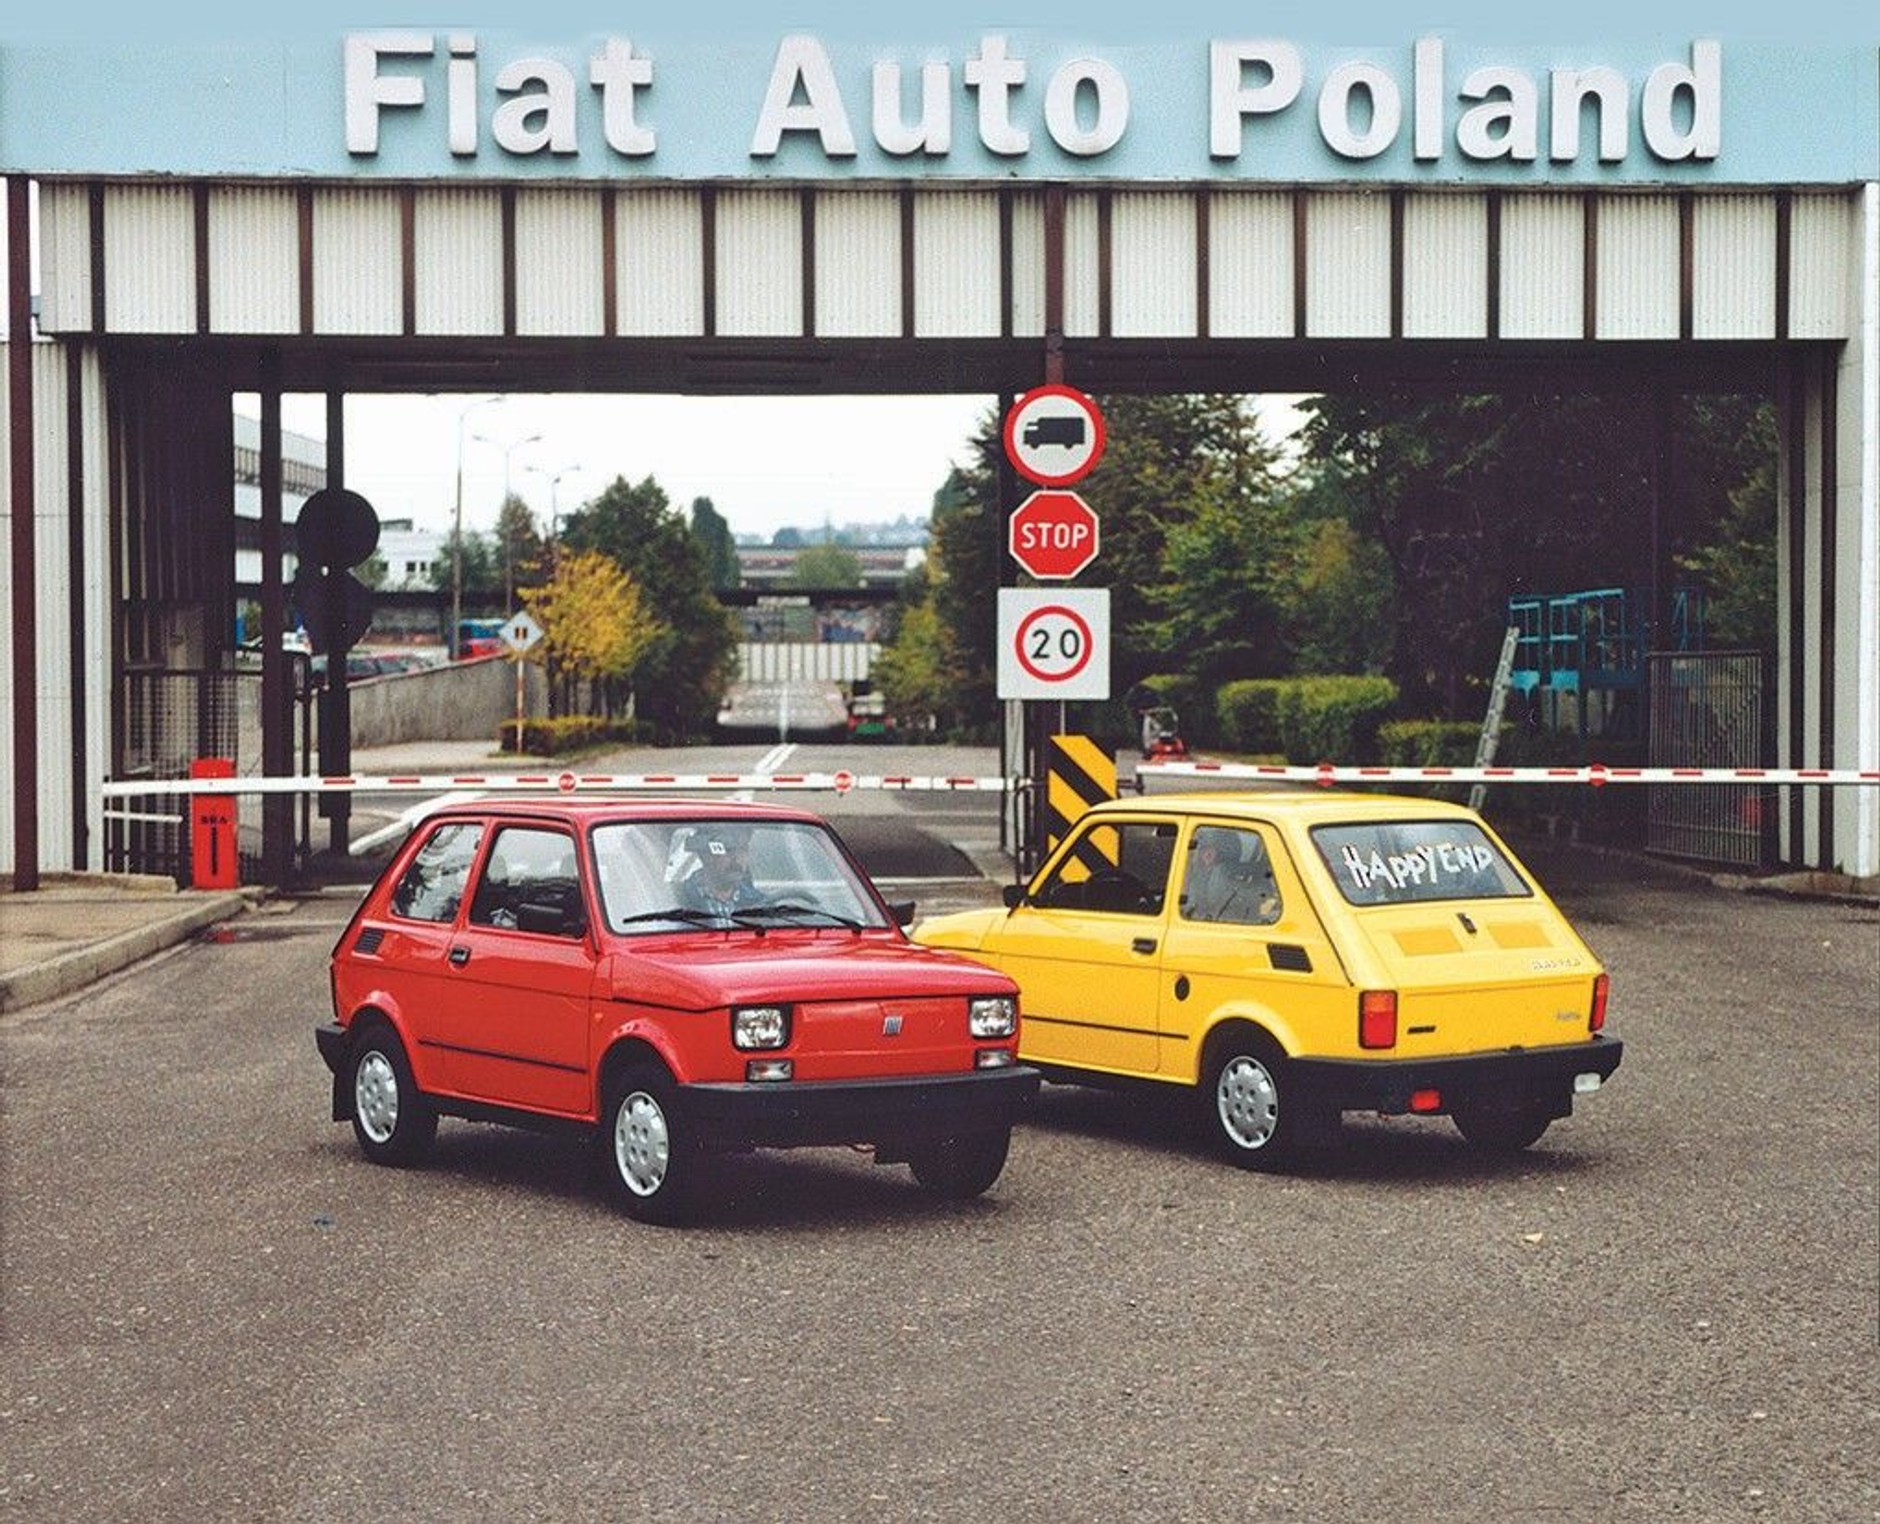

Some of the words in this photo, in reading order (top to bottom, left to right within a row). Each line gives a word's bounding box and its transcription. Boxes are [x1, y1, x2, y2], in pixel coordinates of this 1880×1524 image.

[343, 31, 657, 157] Fiat
[749, 33, 1130, 158] Auto
[1208, 36, 1723, 162] Poland
[1020, 522, 1090, 549] STOP
[1031, 628, 1081, 659] 20
